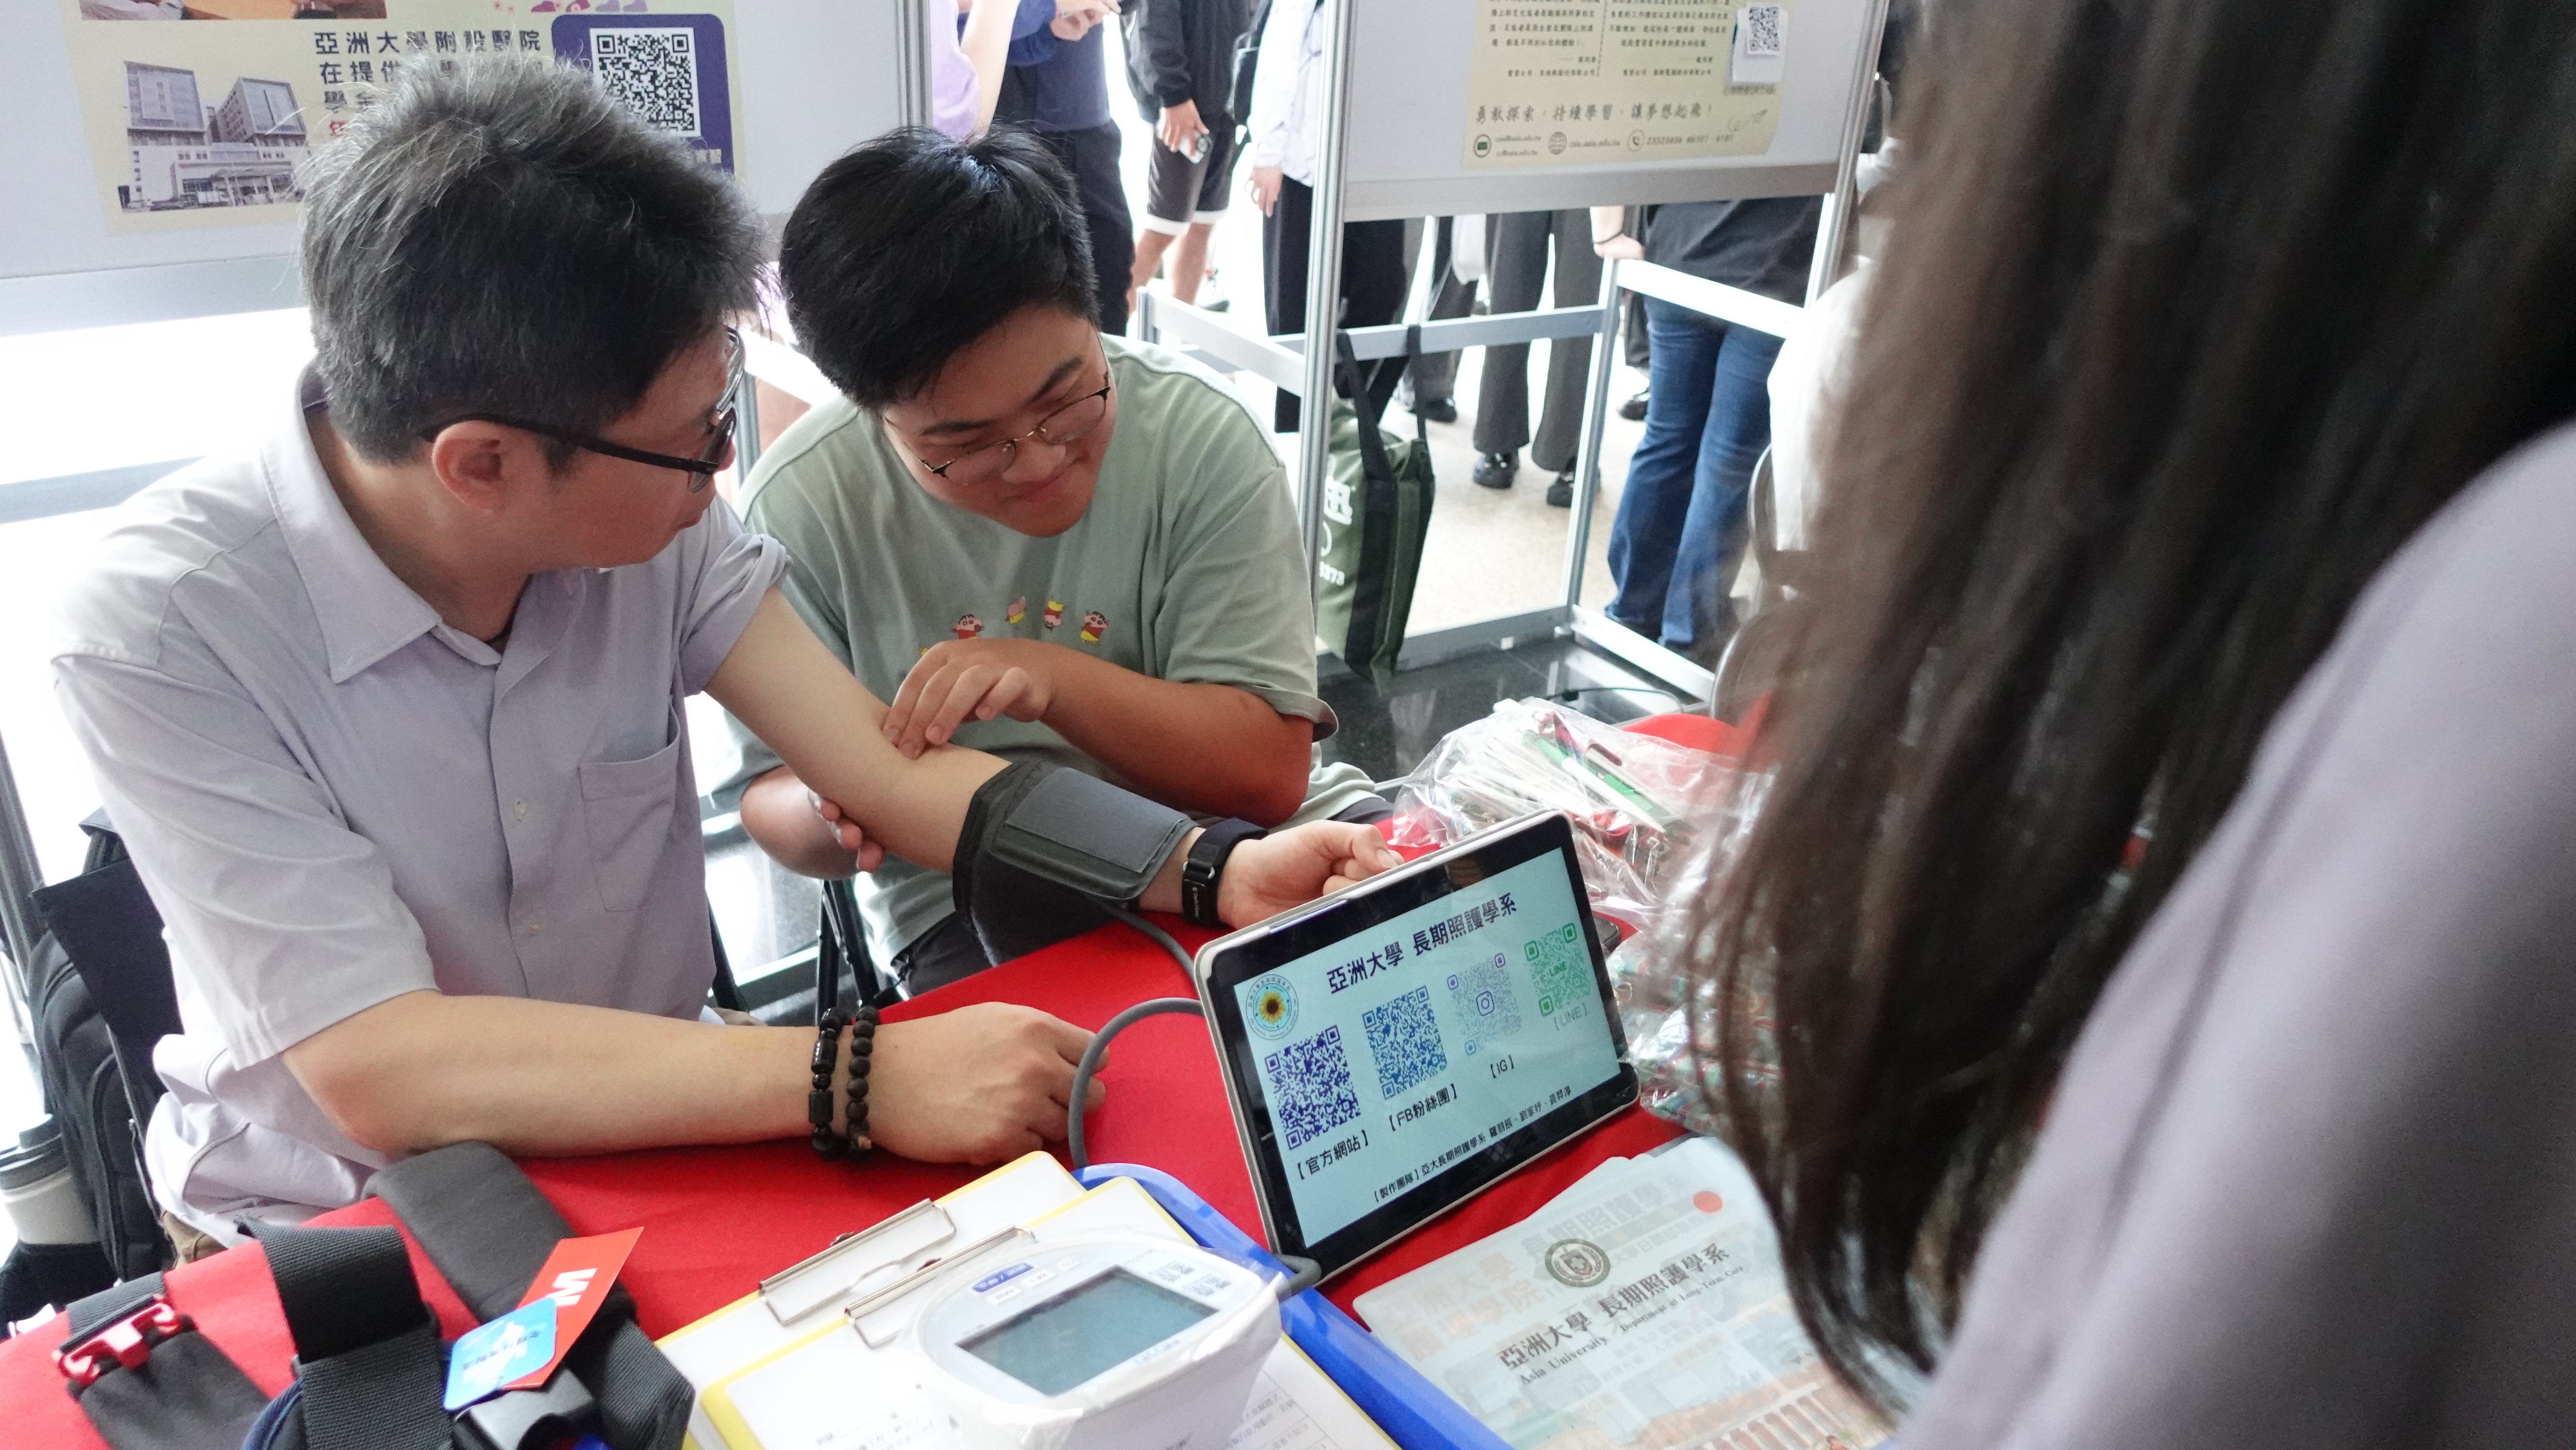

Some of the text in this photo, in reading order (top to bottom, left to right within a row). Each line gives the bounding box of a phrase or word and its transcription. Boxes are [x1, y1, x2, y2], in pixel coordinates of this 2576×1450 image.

[1327, 892, 1517, 994] 亞洲大學 長期照護學系
[1549, 961, 1567, 976] LINE
[1389, 1083, 1457, 1131] 【FB粉絲團】
[1297, 1129, 1369, 1180] 【官方網站】
[1497, 1311, 1592, 1370] 亞洲大學
[1598, 1243, 1729, 1317] 長期照護學系
[1519, 1367, 1547, 1385] Asia
[1548, 1335, 1608, 1369] University
[1620, 1304, 1667, 1333] Department
[1670, 1297, 1679, 1307] of
[1679, 1274, 1723, 1301] Long-Term
